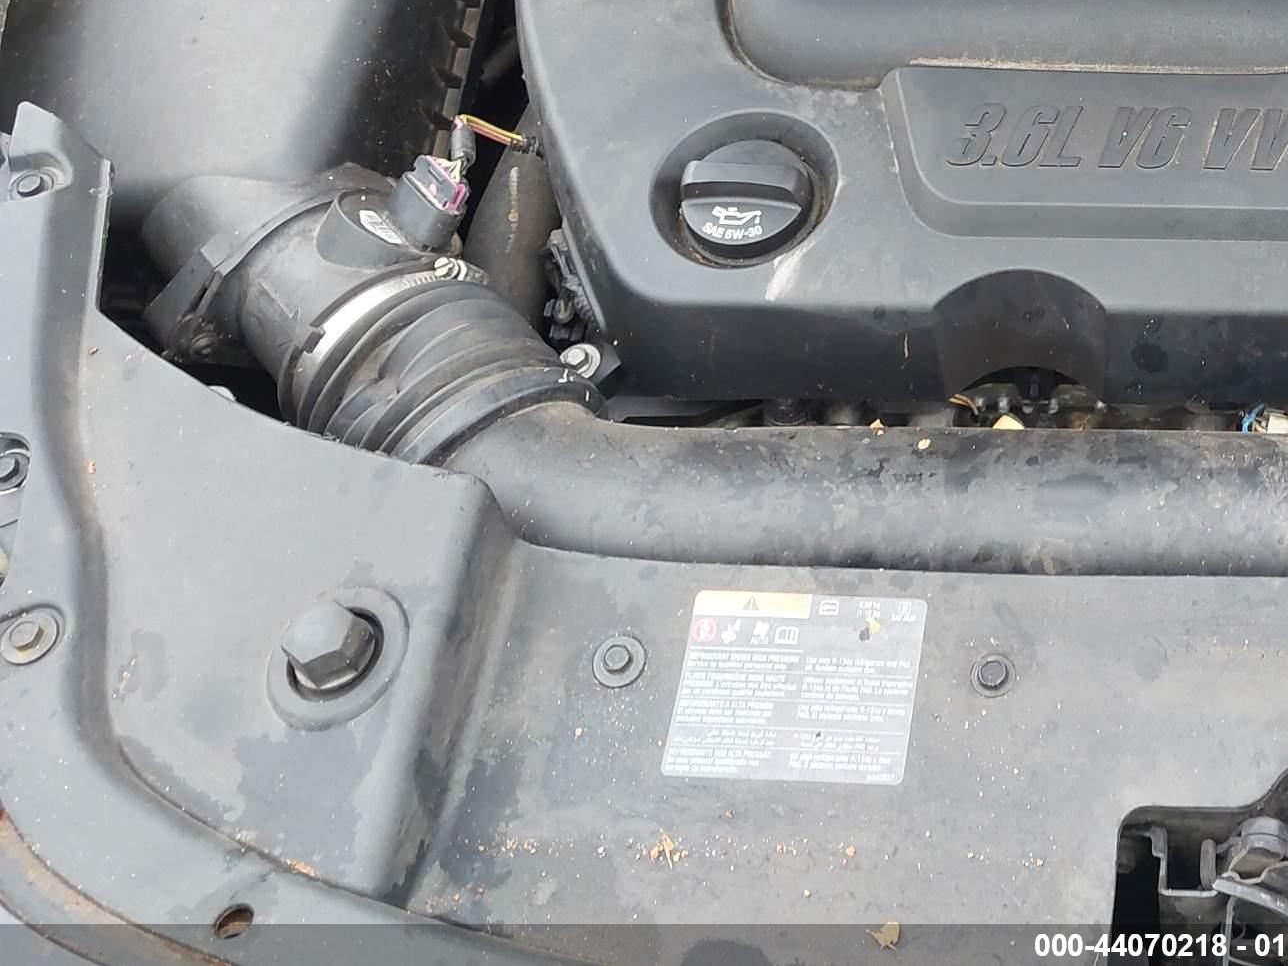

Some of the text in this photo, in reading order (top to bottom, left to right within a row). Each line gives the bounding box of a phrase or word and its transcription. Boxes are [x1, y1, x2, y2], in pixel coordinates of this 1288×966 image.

[946, 103, 1084, 167] 3.6L
[1098, 107, 1191, 169] V6
[702, 222, 763, 240] SAE 5W-30
